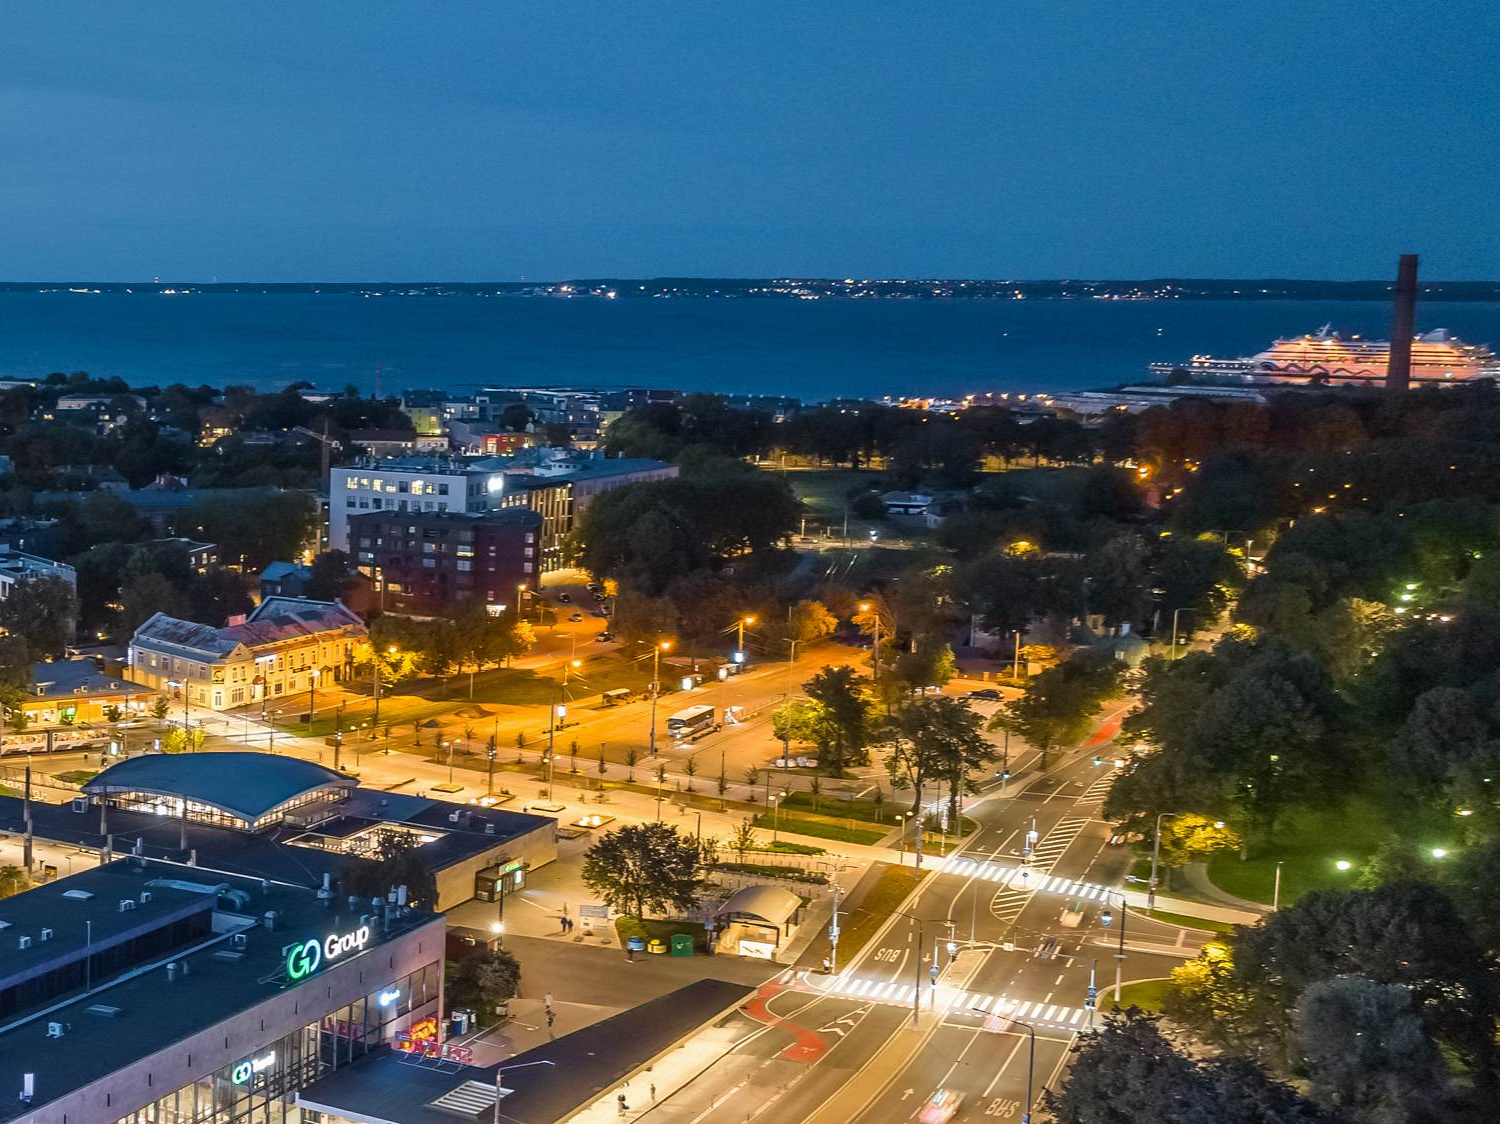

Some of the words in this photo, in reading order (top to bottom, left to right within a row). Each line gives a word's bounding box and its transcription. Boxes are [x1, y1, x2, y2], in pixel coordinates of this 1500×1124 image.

[324, 926, 369, 959] Group
[874, 948, 901, 962] BUS
[984, 1098, 1020, 1118] BUS
